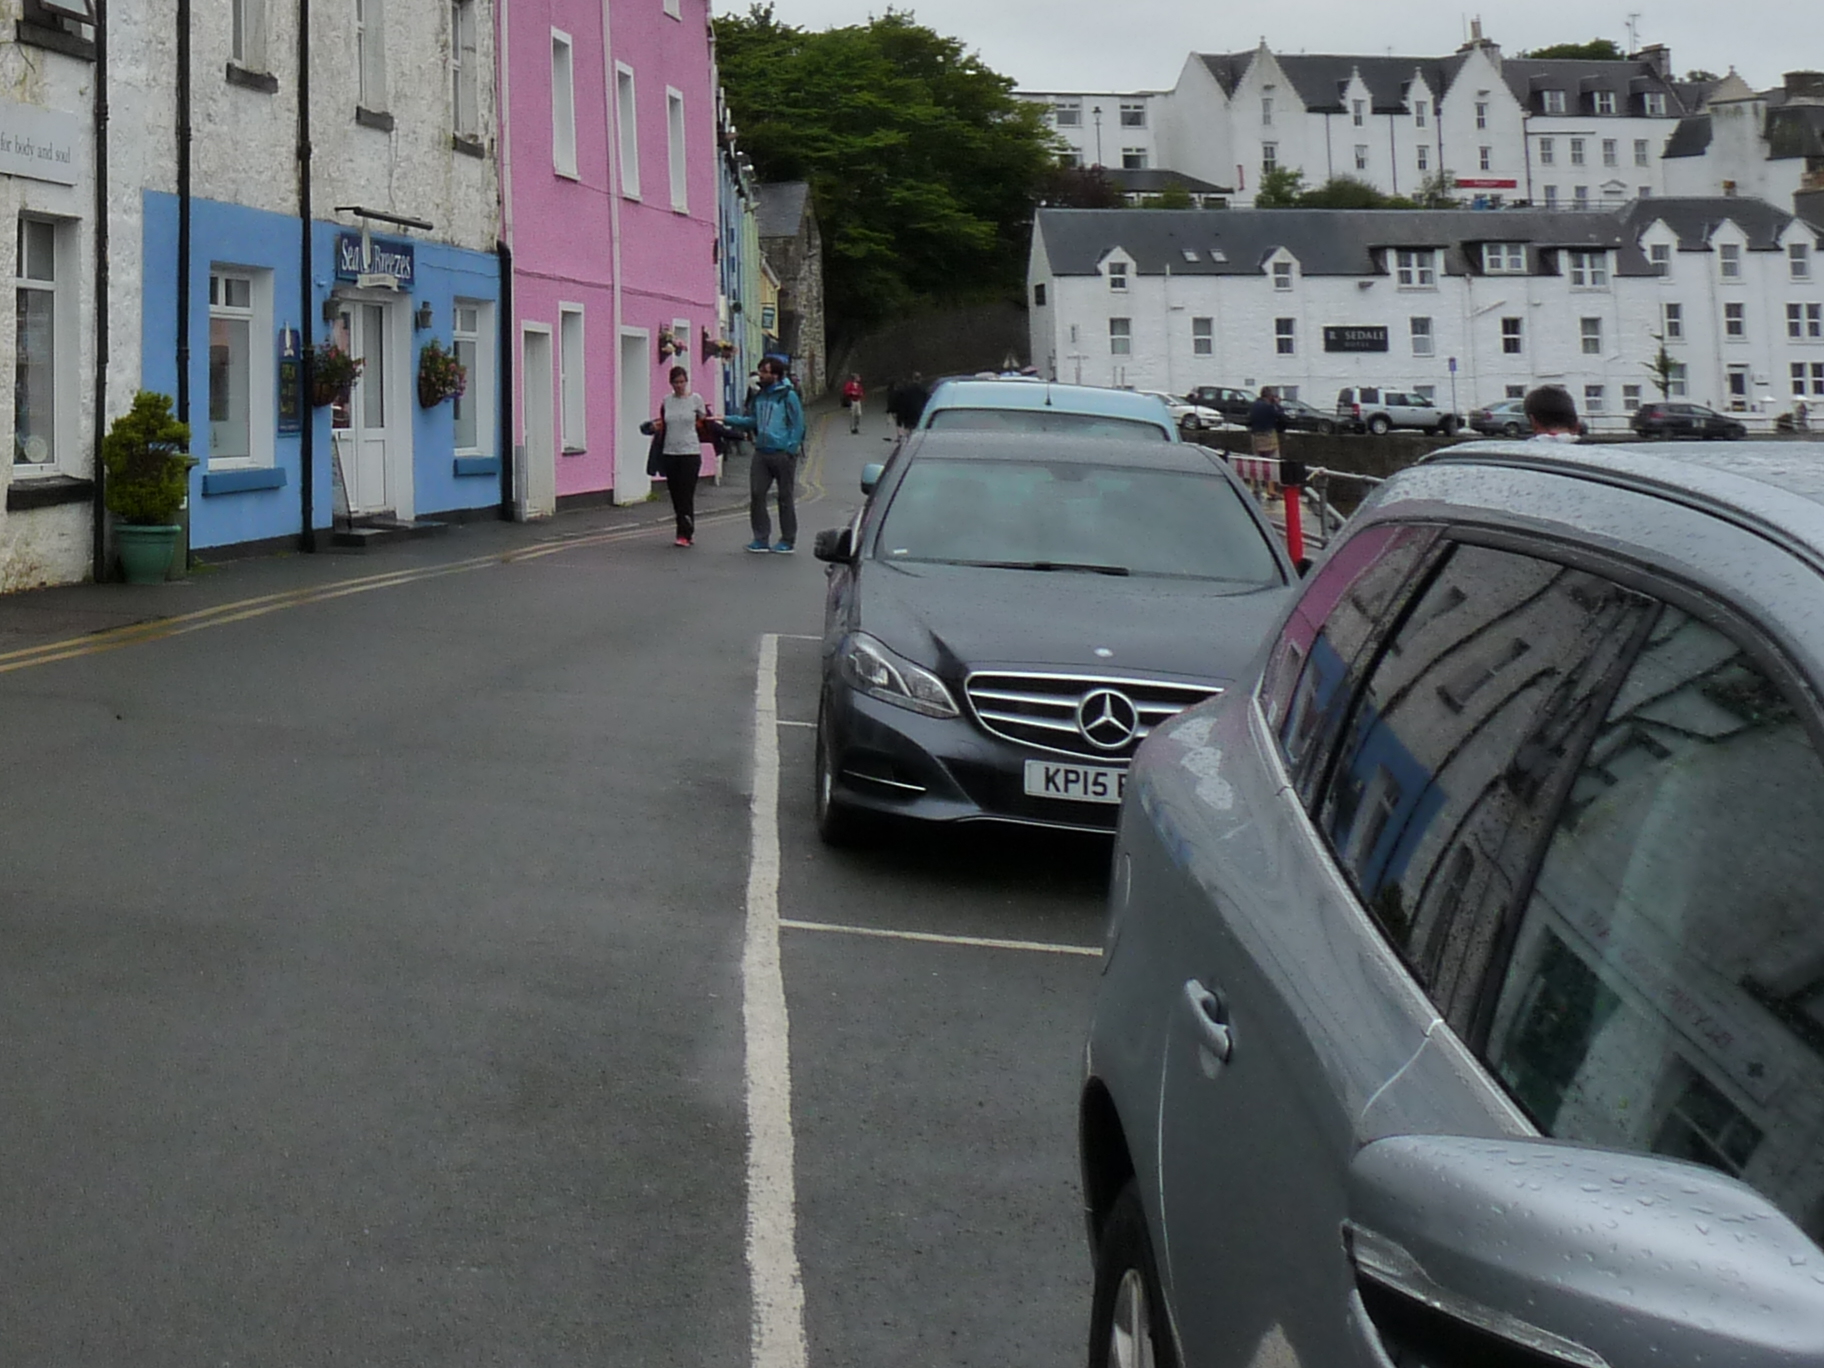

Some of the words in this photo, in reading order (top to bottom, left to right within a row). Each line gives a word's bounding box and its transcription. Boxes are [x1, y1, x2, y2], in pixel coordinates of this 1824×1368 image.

[0, 131, 13, 152] for
[14, 134, 35, 161] body
[37, 142, 53, 160] and
[55, 146, 71, 163] soul
[341, 238, 359, 271] Sea
[374, 244, 411, 279] Breezes
[1328, 330, 1385, 340] RSEDALE
[1044, 766, 1108, 796] KP15
